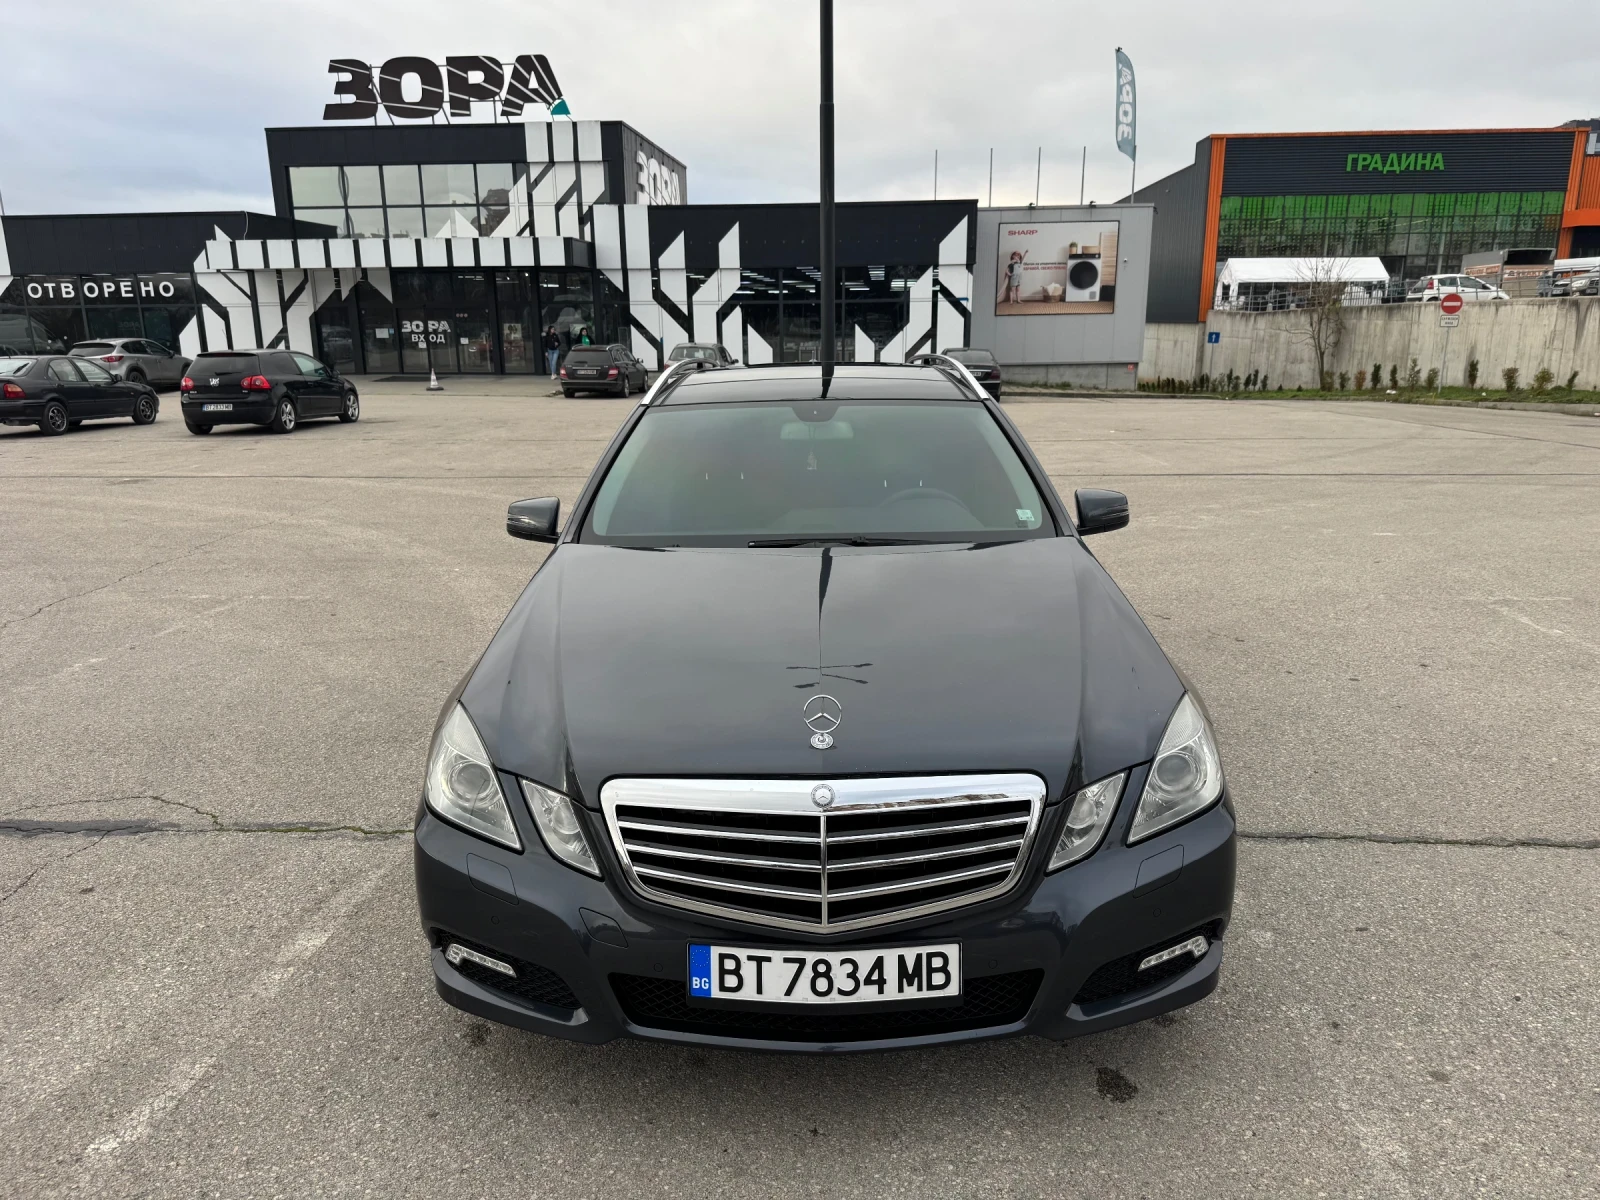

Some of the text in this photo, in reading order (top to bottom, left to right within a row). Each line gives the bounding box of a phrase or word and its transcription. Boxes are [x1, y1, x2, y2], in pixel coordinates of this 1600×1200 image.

[322, 54, 571, 120] ЗОРА
[1117, 63, 1133, 142] ЗОРА
[1346, 152, 1445, 174] ГРАДИНА
[27, 281, 175, 299] ОТВОРЕНО
[692, 976, 710, 990] BG
[718, 951, 951, 997] BT 7834 MB
